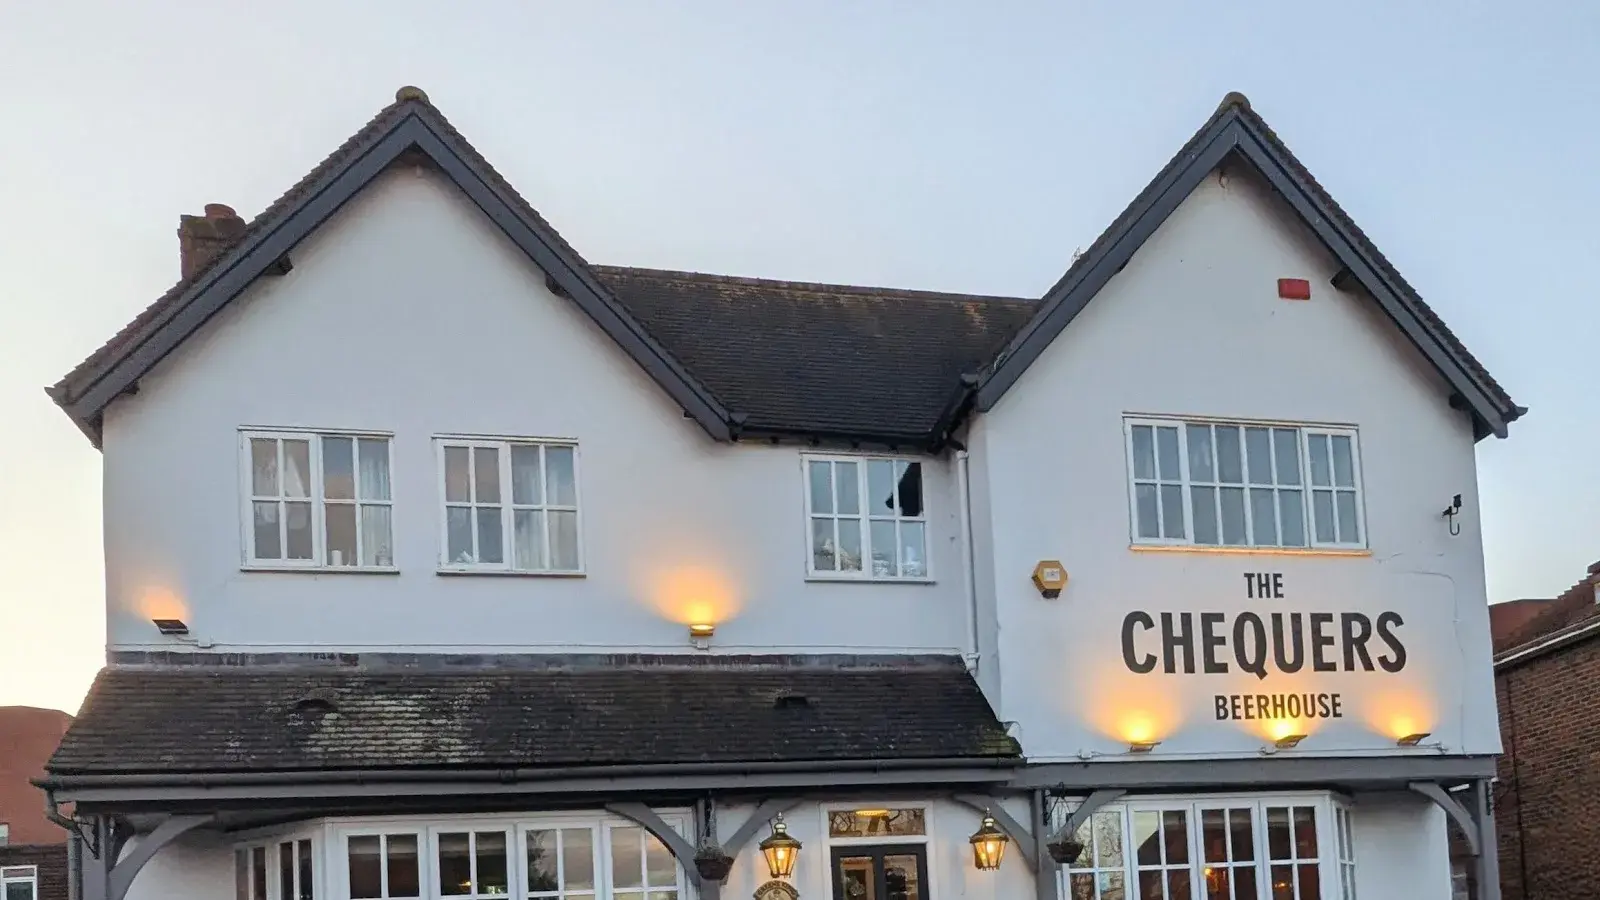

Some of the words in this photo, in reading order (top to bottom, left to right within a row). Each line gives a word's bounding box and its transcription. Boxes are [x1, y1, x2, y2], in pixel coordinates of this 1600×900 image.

[1244, 573, 1284, 598] THE
[1121, 611, 1407, 680] CHEQUERS
[1215, 693, 1343, 721] BEERHOUSE
